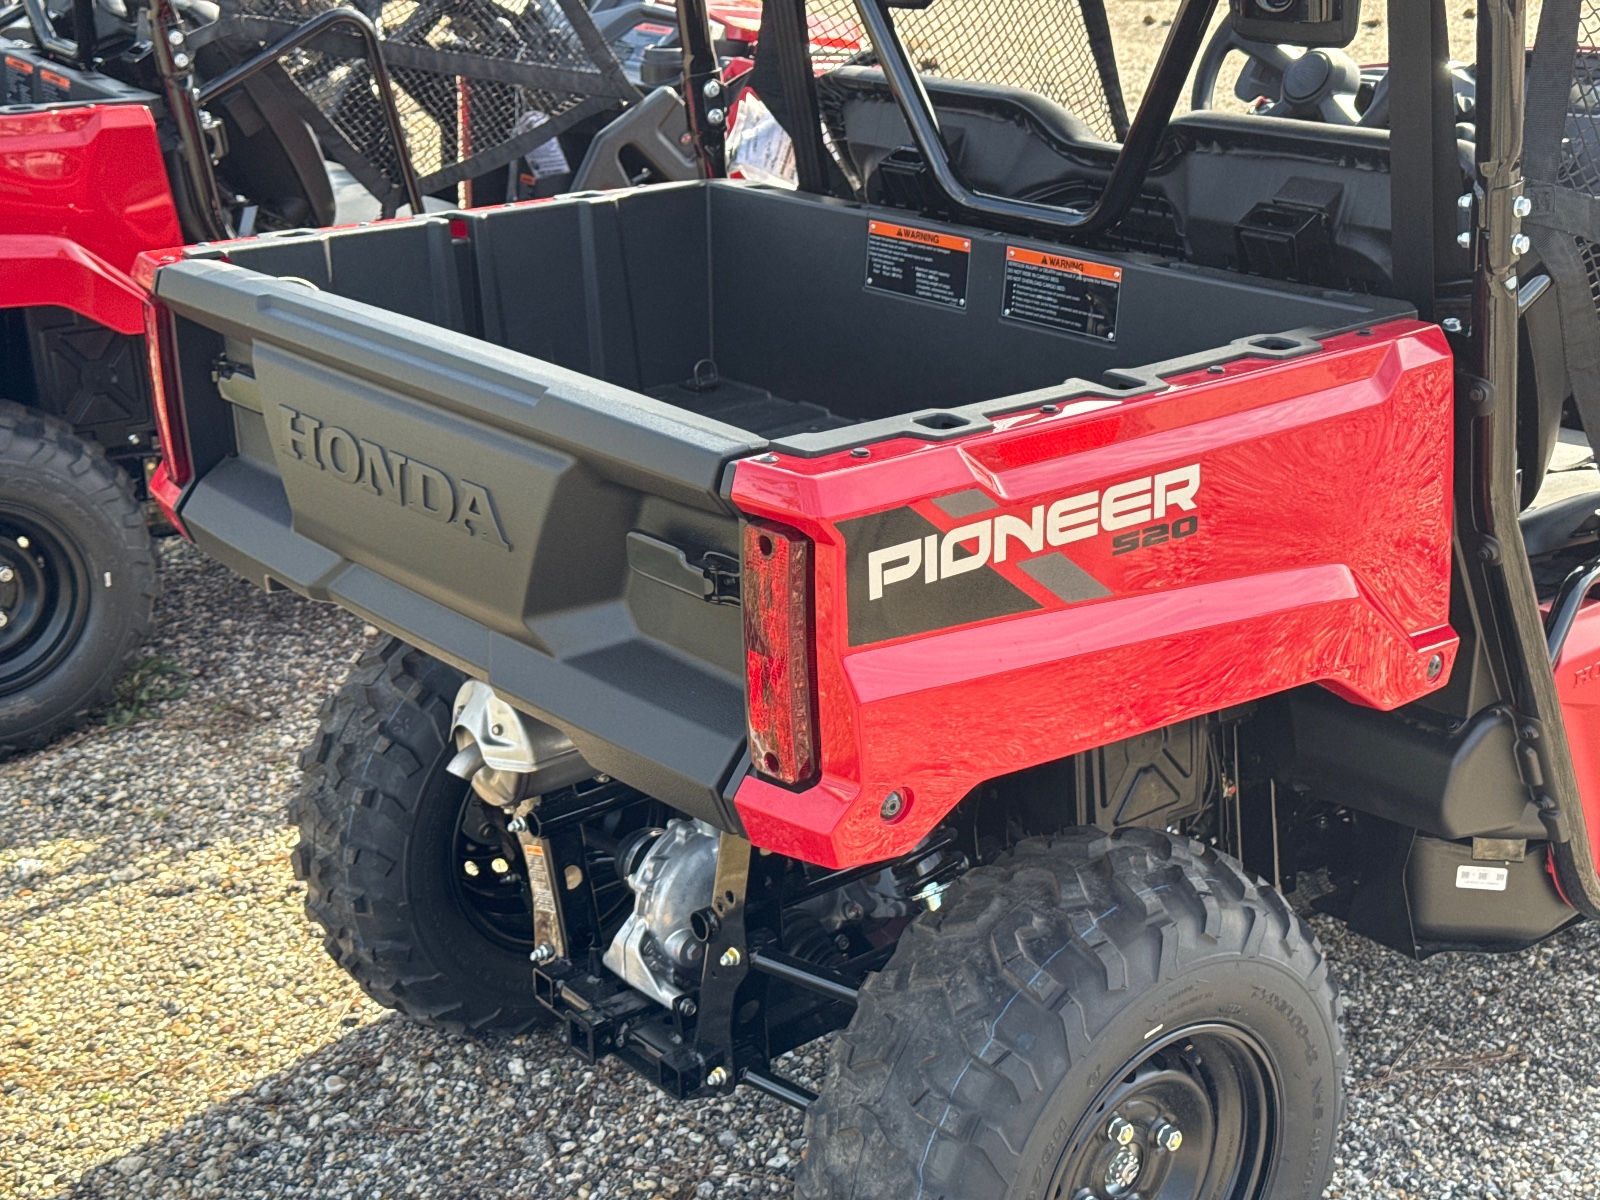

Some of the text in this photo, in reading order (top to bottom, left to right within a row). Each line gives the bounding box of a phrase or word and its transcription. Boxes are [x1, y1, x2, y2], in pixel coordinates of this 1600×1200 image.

[904, 229, 940, 244] WARNING
[1049, 257, 1084, 272] WARNING
[278, 403, 514, 552] HONDA
[868, 463, 1200, 601] PIONEER
[1112, 515, 1198, 557] 520
